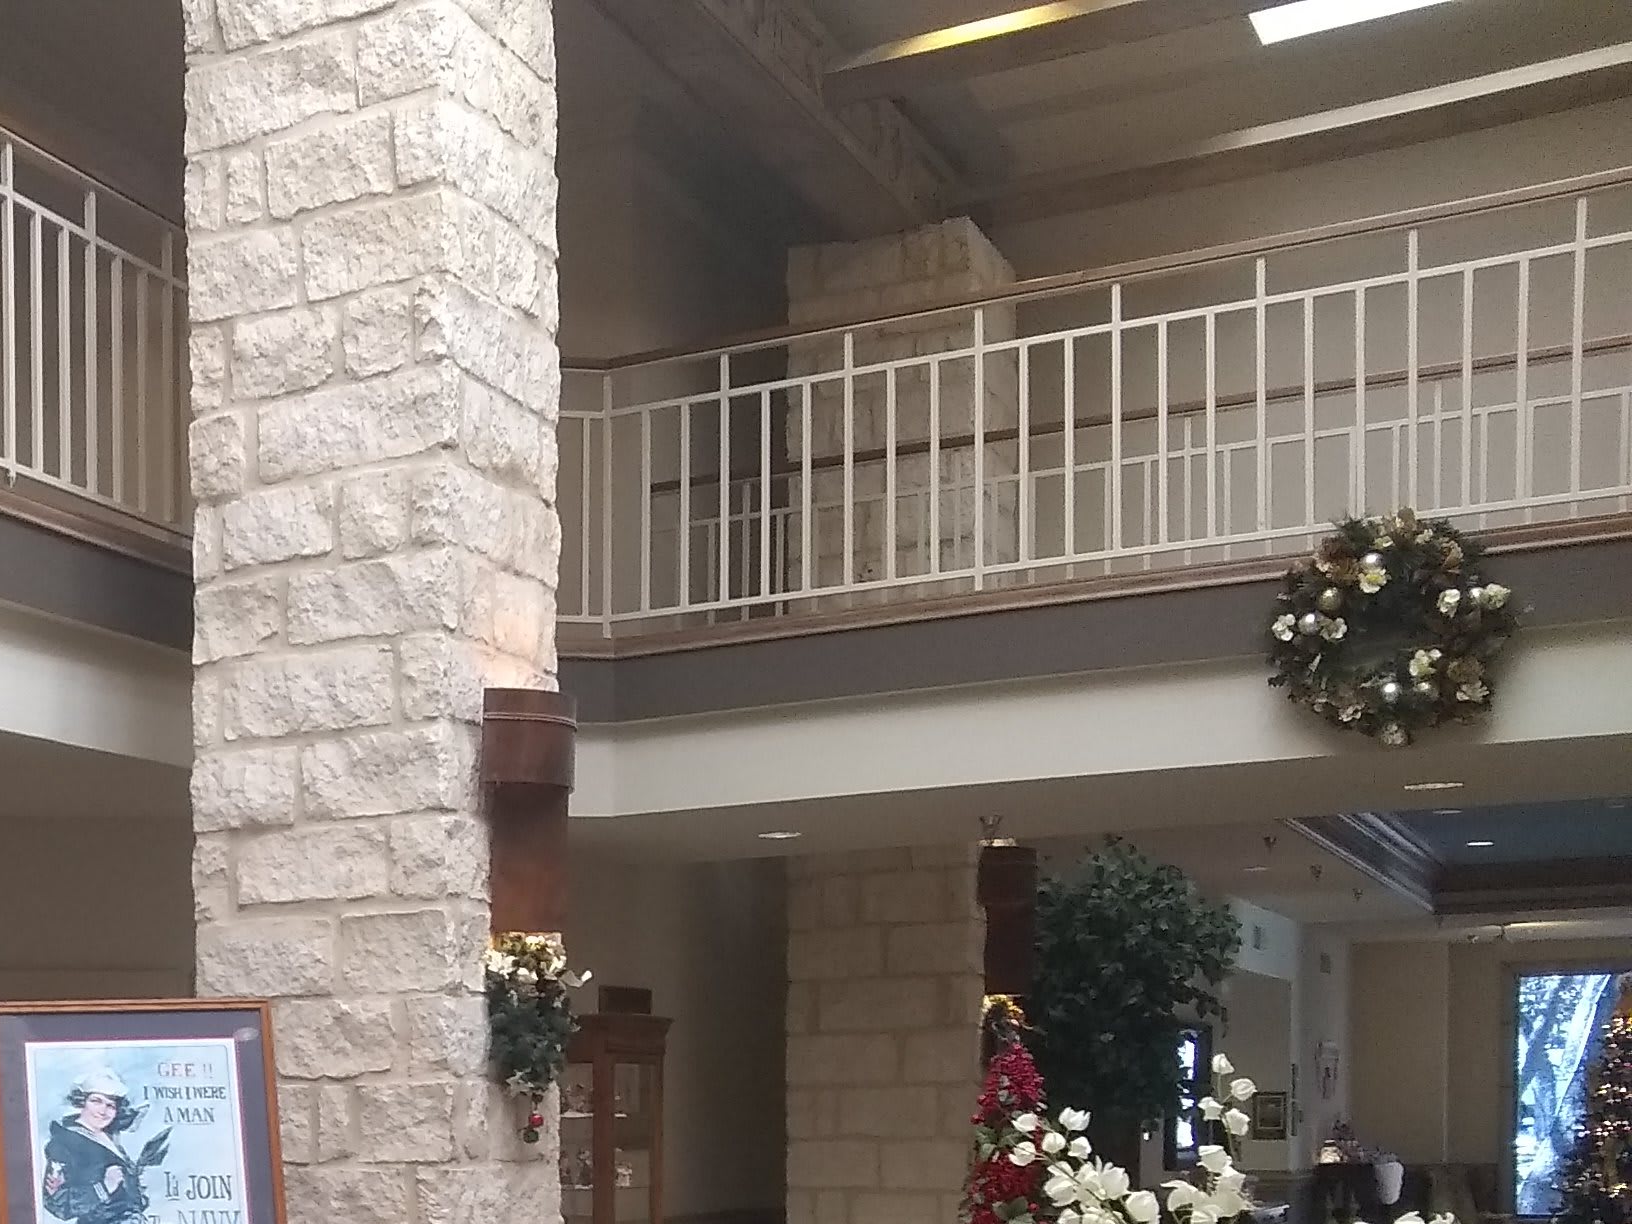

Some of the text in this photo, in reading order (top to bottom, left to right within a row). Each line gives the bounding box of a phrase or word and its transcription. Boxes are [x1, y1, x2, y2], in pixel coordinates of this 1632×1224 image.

[157, 1062, 196, 1078] GEE
[143, 1085, 227, 1101] I WISH I WERE
[164, 1105, 215, 1123] A MAN
[185, 1174, 233, 1201] JOIN
